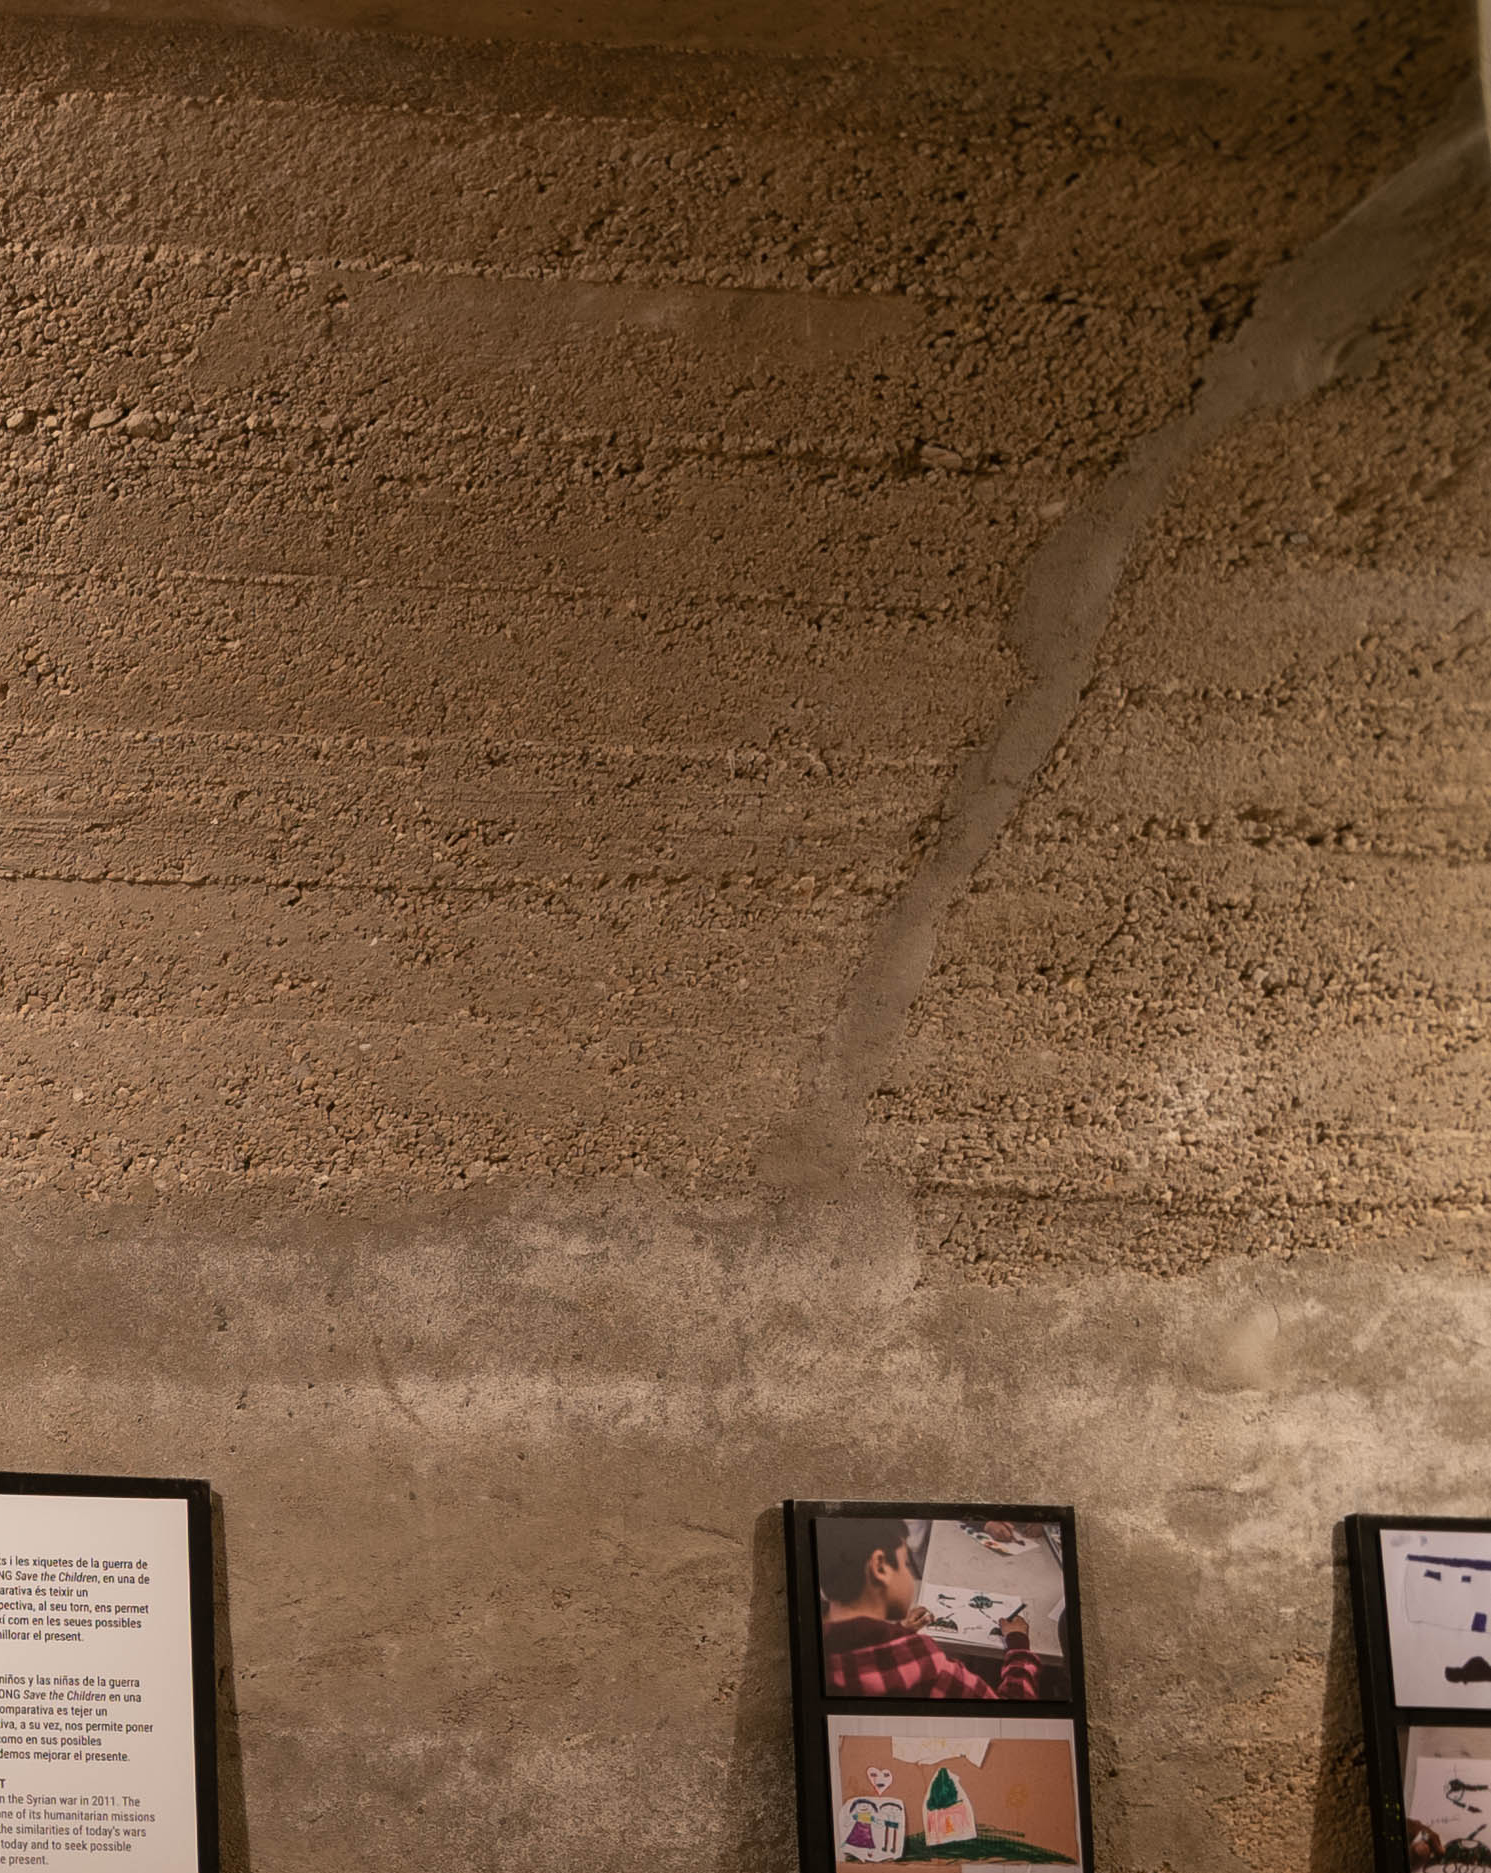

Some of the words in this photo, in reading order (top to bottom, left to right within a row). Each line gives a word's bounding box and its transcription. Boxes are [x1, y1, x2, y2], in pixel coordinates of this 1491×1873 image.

[33, 1584, 47, 1596] és
[48, 1585, 74, 1596] teixir
[75, 1588, 88, 1597] un
[7, 1616, 29, 1625] com
[31, 1616, 44, 1625] en
[45, 1614, 61, 1626] les
[62, 1617, 93, 1626] seues
[94, 1615, 142, 1630] possibles
[32, 1628, 42, 1640] el
[24, 1735, 38, 1744] en
[39, 1736, 58, 1745] sus
[59, 1734, 102, 1748] posibles
[32, 1748, 71, 1763] mejorar
[72, 1749, 82, 1760] el
